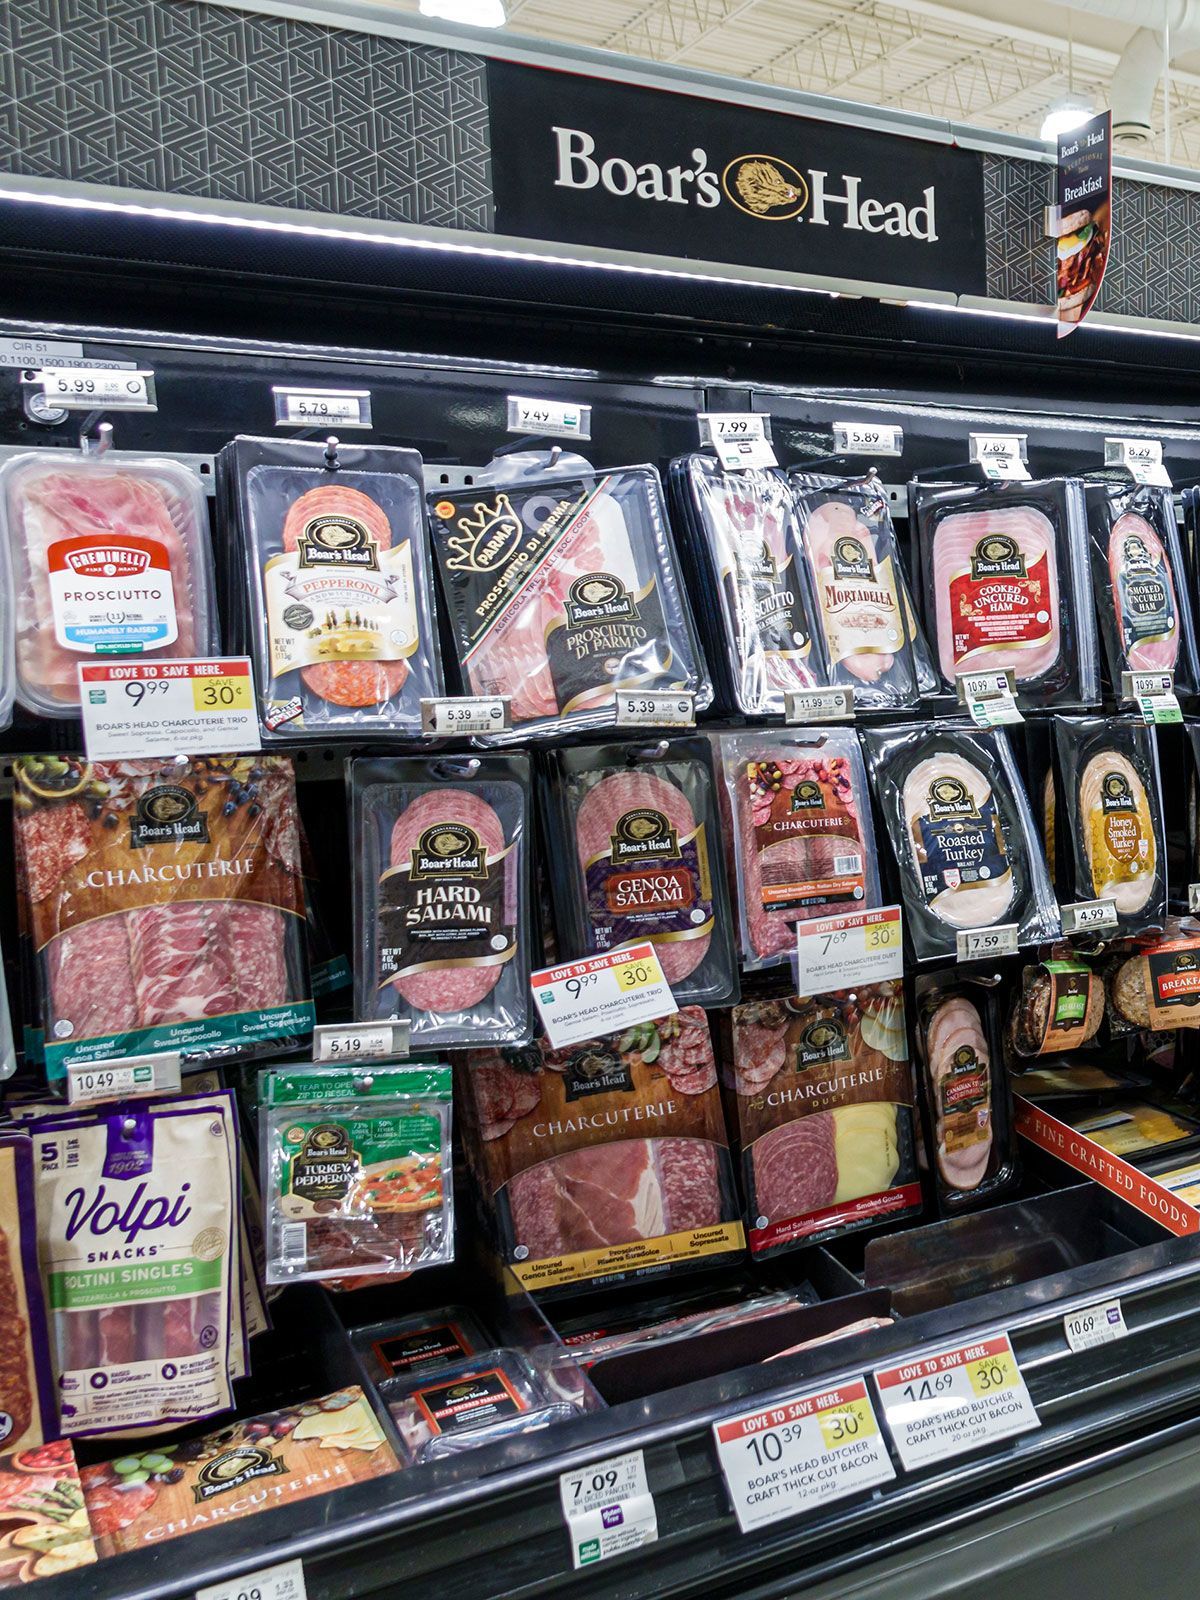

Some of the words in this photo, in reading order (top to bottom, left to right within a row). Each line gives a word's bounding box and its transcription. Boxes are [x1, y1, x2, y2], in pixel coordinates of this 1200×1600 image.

[1087, 128, 1104, 147] Head
[552, 127, 721, 208] Boar's
[808, 169, 938, 243] Head
[1064, 176, 1102, 202] Breakfast
[13, 342, 30, 352] CIR
[35, 343, 48, 352] 51
[58, 378, 95, 392] 5.99
[299, 402, 328, 415] 5.79
[717, 421, 747, 434] 7.99
[853, 431, 879, 443] 5.89
[1128, 446, 1150, 457] 8.29
[479, 522, 515, 566] PARMA
[69, 550, 146, 568] CREMINELLI
[308, 548, 338, 561] Boar's
[342, 549, 370, 561] Head
[475, 552, 529, 618] PROSCIUTTO
[527, 537, 542, 556] DI
[539, 499, 571, 536] PARMA
[977, 562, 999, 573] Boar's
[1002, 561, 1020, 572] Head
[303, 579, 380, 594] PEPPERONI
[980, 586, 1020, 596] COOKED
[1128, 585, 1160, 596] SMOKED
[64, 589, 161, 601] PROSCIUTTO
[493, 593, 527, 635] AGRICOLA
[525, 573, 540, 593] TRE
[537, 554, 557, 580] VALLI
[825, 585, 893, 607] MORTADELLA
[974, 593, 1028, 607] UNCURED
[574, 604, 603, 619] Boar's
[605, 602, 629, 616] Head
[990, 602, 1013, 612] HAM
[1140, 602, 1156, 612] HAM
[75, 626, 123, 636] HUMANELY
[126, 625, 158, 635] RAISED
[567, 624, 646, 651] PROSCIUTTO
[576, 645, 589, 659] DI
[593, 638, 640, 651] PARMA
[110, 667, 139, 678] LOVE
[144, 667, 158, 677] TO
[163, 666, 189, 677] SAVE
[195, 665, 224, 676] HERE.
[208, 679, 234, 687] SAVE
[447, 709, 471, 720] 5.39
[628, 701, 655, 713] 5.39
[96, 722, 131, 732] BOAR'S
[133, 720, 158, 729] HEAD
[161, 718, 224, 728] CHARCUTERIE
[227, 716, 247, 725] TRIO
[934, 804, 952, 815] Boar's
[954, 802, 971, 813] Head
[139, 824, 171, 837] Boar's
[174, 822, 200, 834] Head
[1110, 817, 1133, 830] Honey
[937, 832, 985, 848] Roasted
[1109, 826, 1136, 839] Smoked
[620, 841, 646, 854] Boar's
[649, 839, 671, 851] Head
[1111, 836, 1135, 851] Turkey
[420, 856, 448, 869] Boar's
[451, 855, 478, 868] Head
[943, 845, 984, 864] Turkey
[88, 859, 254, 889] CHARCUTERIE
[618, 876, 679, 894] GENOA
[417, 886, 481, 905] HARD
[617, 889, 683, 906] SALAMI
[406, 904, 491, 927] SALAMI
[1080, 909, 1103, 921] 4.99
[973, 936, 998, 949] 7.59
[551, 967, 571, 981] LOVE
[575, 965, 586, 975] TO
[590, 960, 609, 973] SAVE
[613, 953, 634, 967] HERE.
[806, 965, 824, 973] BOAR'S
[826, 962, 841, 971] HEAD
[843, 956, 879, 968] CHARCUTERIE
[881, 952, 896, 961] DUET
[552, 1012, 576, 1025] BOAR'S
[578, 1006, 598, 1018] HEAD
[600, 994, 644, 1012] CHARCUTERIE
[646, 988, 662, 997] TRIO
[259, 1011, 291, 1022] Uncured
[171, 1024, 205, 1037] Uncured
[154, 1037, 179, 1048] Sweet
[182, 1030, 221, 1044] Capocollo
[331, 1039, 361, 1052] 5.19
[76, 1041, 114, 1053] Uncured
[572, 1078, 601, 1091] Boar's
[603, 1073, 626, 1086] Head
[767, 1068, 884, 1107] CHARCUTERIE
[812, 1093, 845, 1108] DUET
[533, 1100, 677, 1139] CHARCUTERIE
[41, 1142, 58, 1162] 5
[109, 1159, 143, 1174] 1902
[304, 1164, 351, 1175] TURKEY
[1034, 1117, 1064, 1148] FINE
[1071, 1138, 1133, 1189] CRAFTED
[1139, 1186, 1188, 1228] FOODS
[856, 1198, 880, 1211] Smoked
[882, 1193, 904, 1206] Gouda
[65, 1183, 192, 1244] Volpi
[690, 1235, 729, 1249] Sopressata
[693, 1229, 723, 1240] Uncured
[122, 1262, 194, 1282] SINGLES
[521, 1271, 545, 1281] Genoa
[547, 1266, 574, 1277] Salame
[532, 1260, 563, 1272] Uncured
[899, 1368, 923, 1380] LOVE
[926, 1361, 937, 1372] TO
[941, 1355, 963, 1368] SAVE
[965, 1346, 989, 1362] HERE.
[742, 1421, 768, 1434] LOVE
[771, 1412, 785, 1422] TO
[790, 1402, 813, 1418] SAVE
[817, 1393, 843, 1409] HERE.
[907, 1416, 942, 1433] BOAR'S
[944, 1406, 969, 1421] HEAD
[971, 1391, 1015, 1412] BUTCHER
[906, 1430, 936, 1446] CRAFT
[938, 1421, 966, 1437] THICK
[968, 1415, 987, 1428] CUT
[989, 1402, 1023, 1421] BACON
[748, 1472, 788, 1491] BOAR'S
[789, 1458, 819, 1475] HEAD
[821, 1441, 869, 1465] BUTCHER
[571, 1471, 617, 1498] 7.09
[746, 1487, 781, 1506] CRAFT
[782, 1474, 815, 1493] THICK
[817, 1466, 838, 1481] CUT
[840, 1452, 879, 1472] BACON
[144, 1464, 349, 1540] CHARCUTERIE
